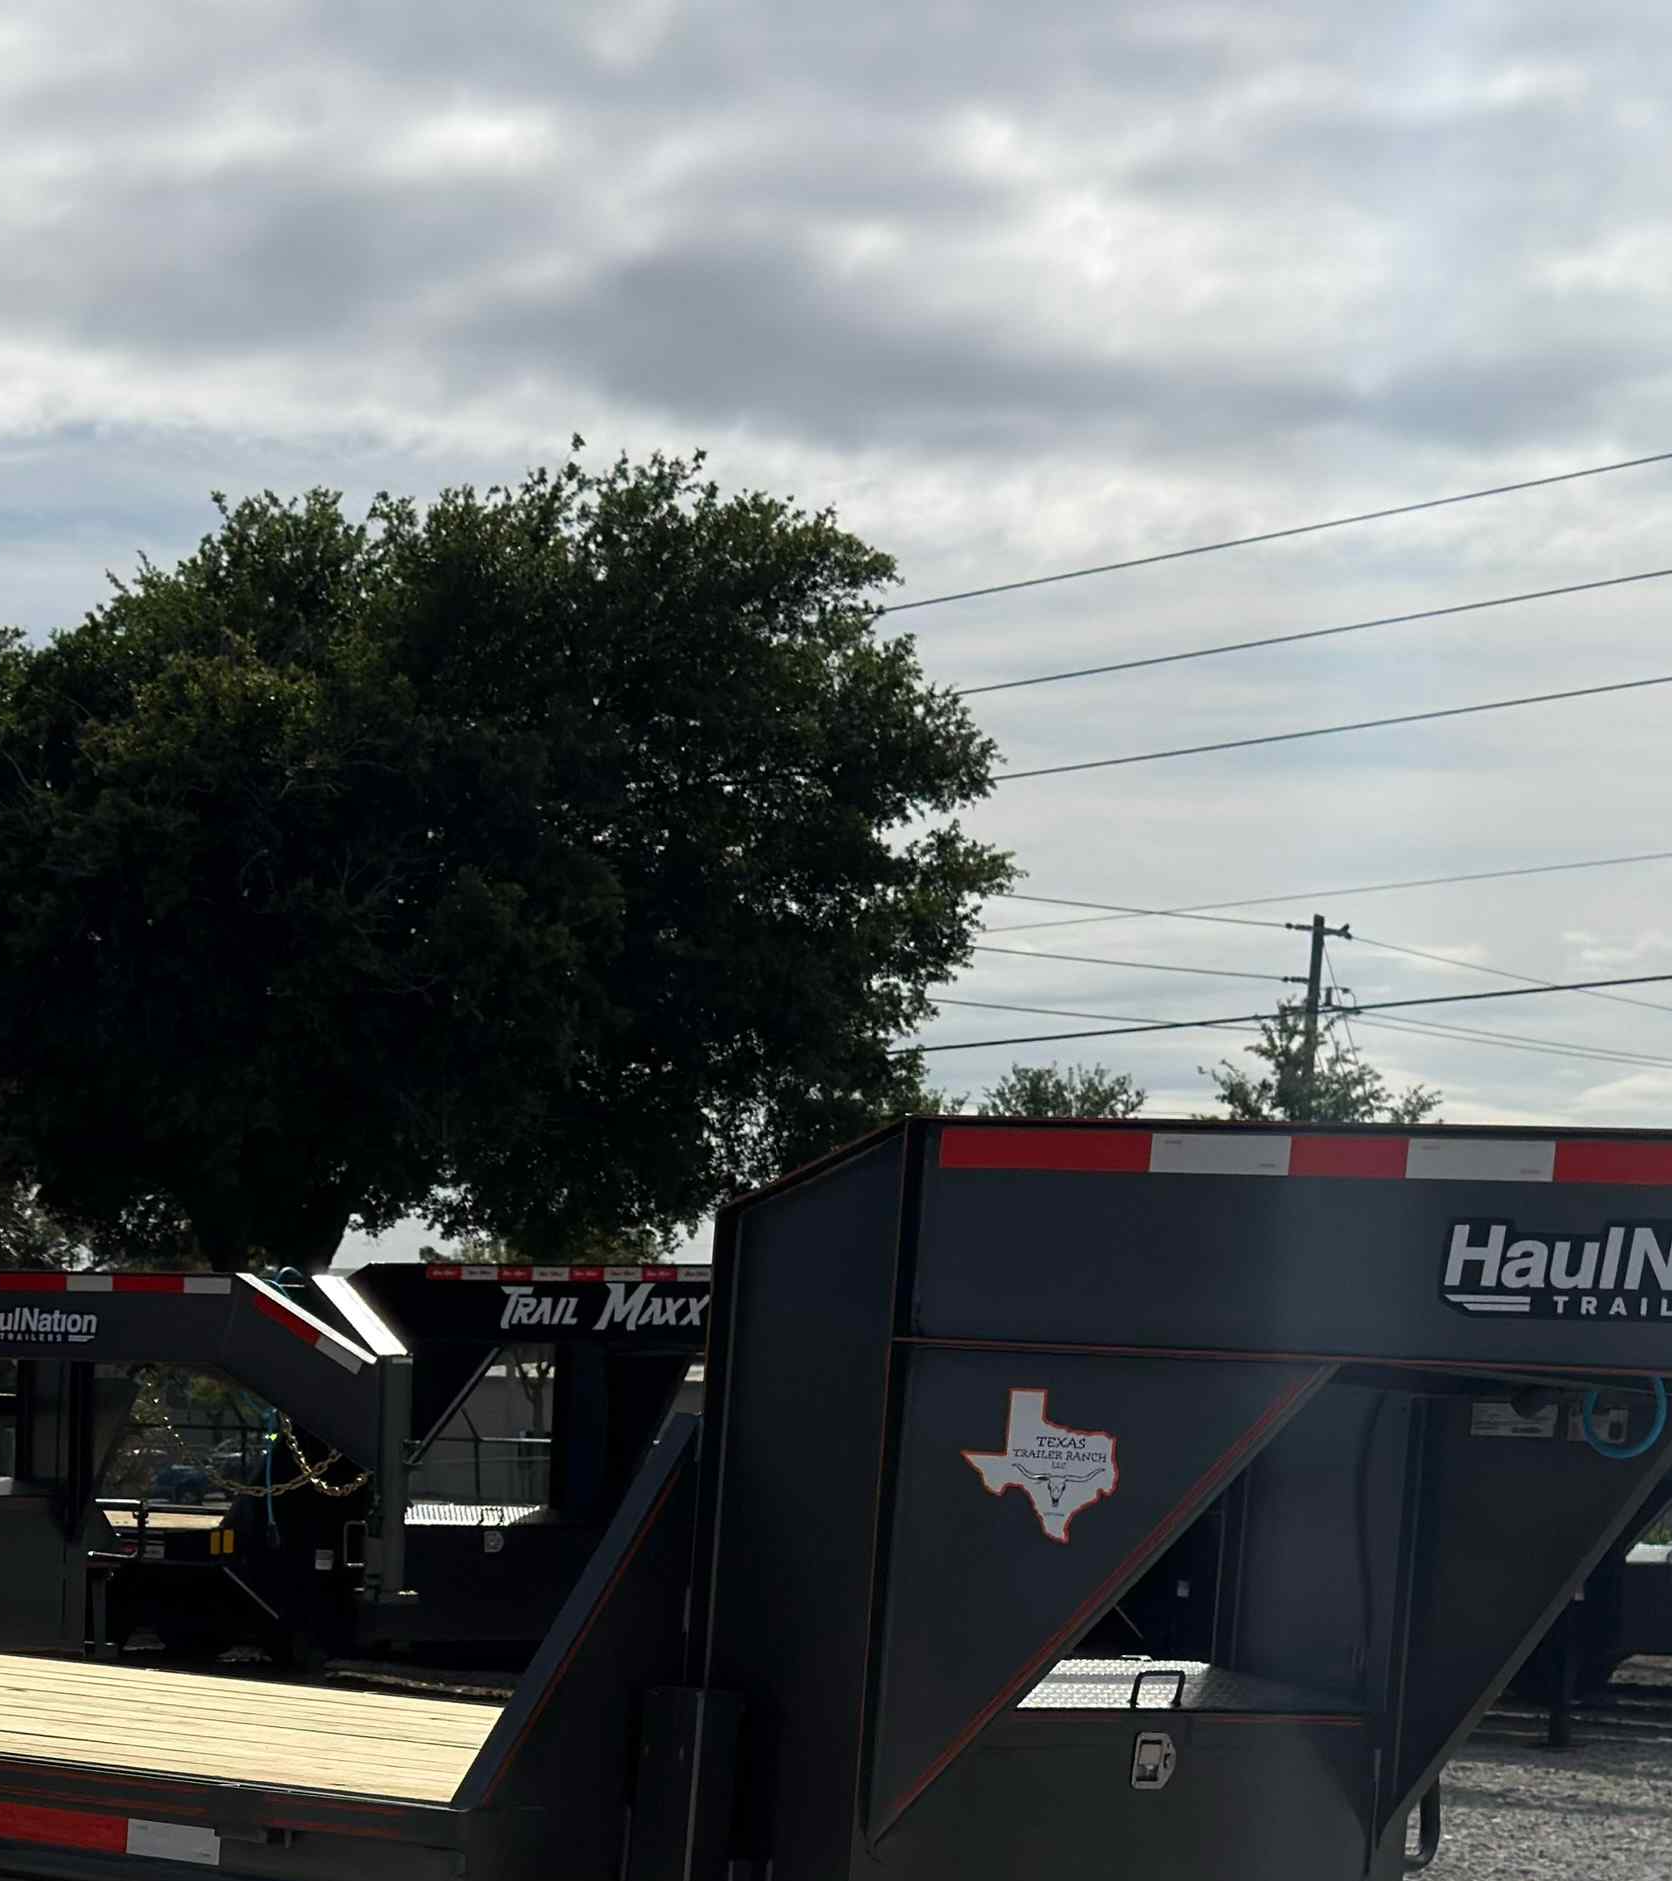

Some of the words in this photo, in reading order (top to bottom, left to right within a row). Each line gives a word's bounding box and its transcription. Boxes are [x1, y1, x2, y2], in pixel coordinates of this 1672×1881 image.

[500, 1285, 579, 1329] TRAIL
[591, 1282, 711, 1331] MAXX
[0, 1332, 63, 1343] TRAILERS
[1036, 1436, 1086, 1449] TEXAS
[1012, 1448, 1063, 1460] TRAILER
[1065, 1450, 1107, 1463] RANCH
